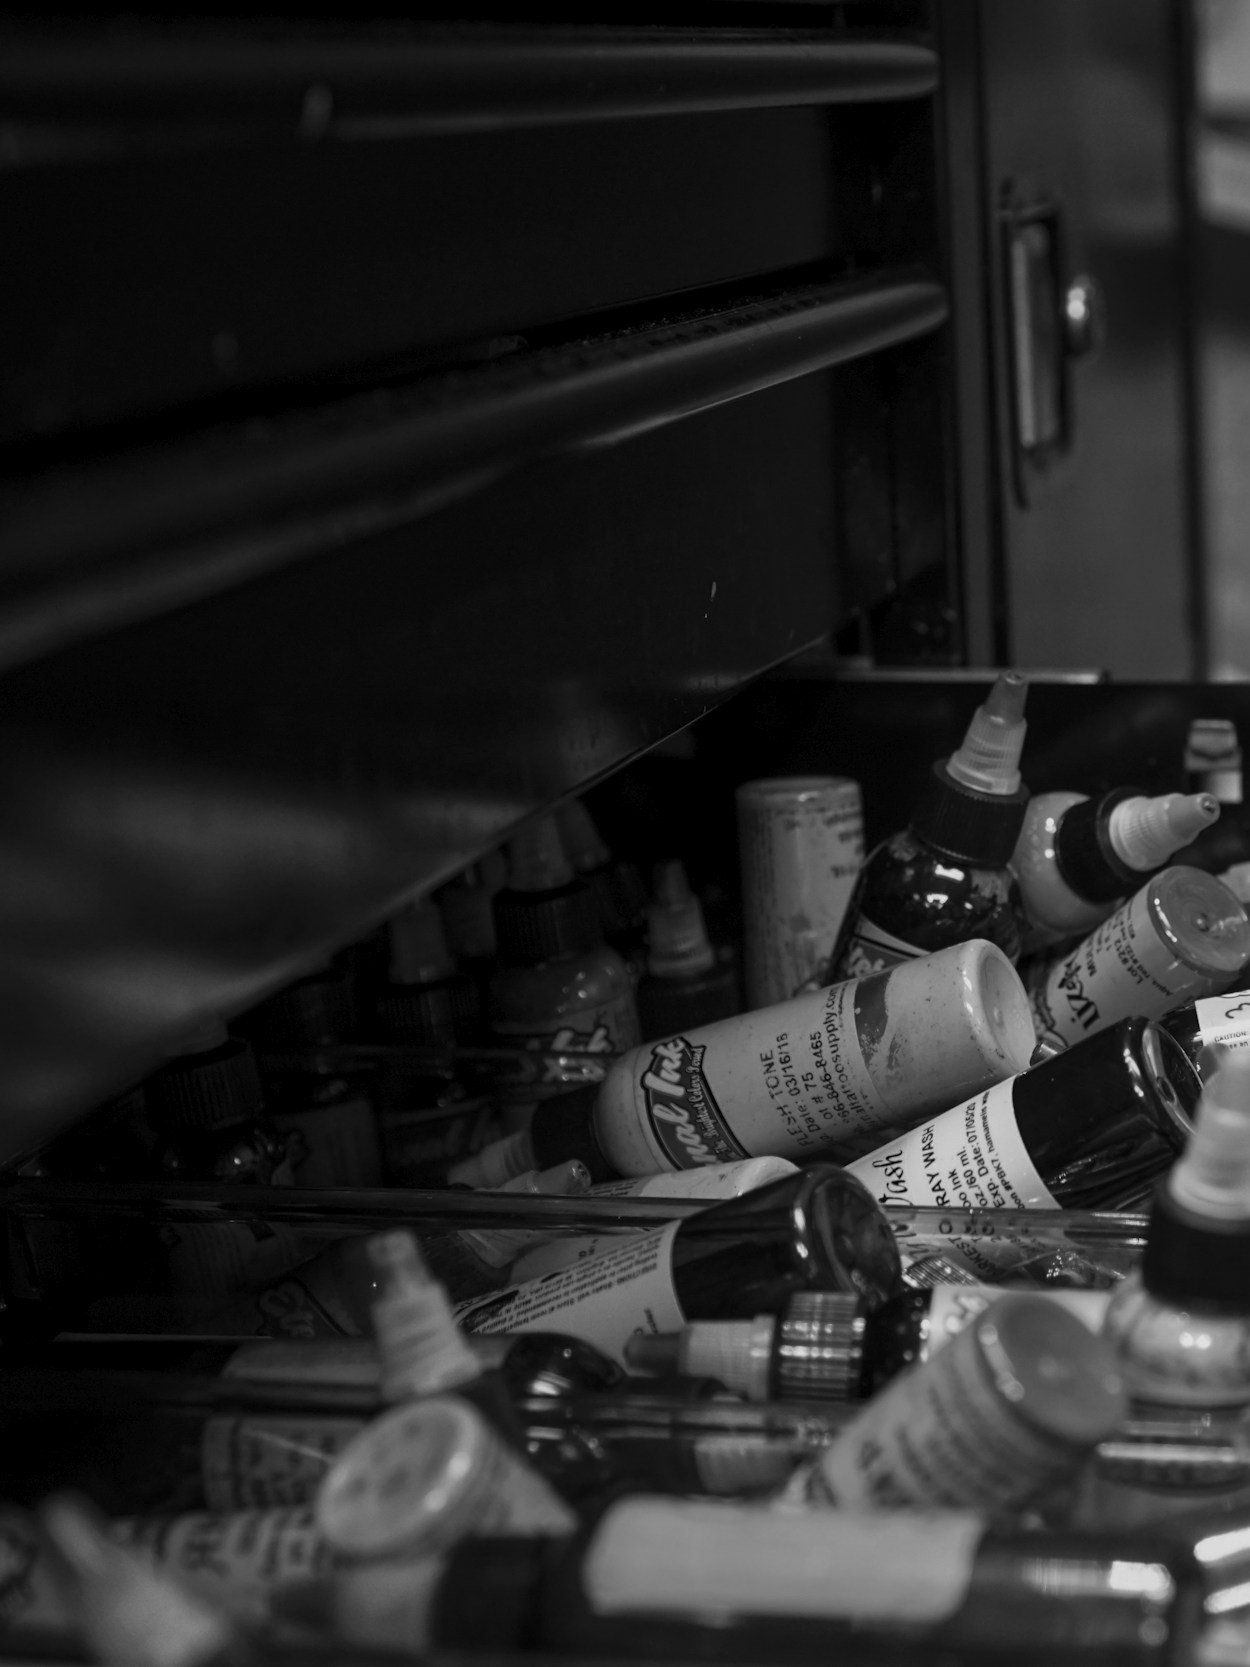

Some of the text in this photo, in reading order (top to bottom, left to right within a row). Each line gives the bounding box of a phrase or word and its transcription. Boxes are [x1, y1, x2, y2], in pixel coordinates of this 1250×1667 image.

[644, 1038, 685, 1096] Ink
[802, 1071, 817, 1091] 75
[760, 1050, 814, 1147] FLESH TONE
[921, 1124, 936, 1169] WASH
[957, 1146, 970, 1166] ml.
[972, 1141, 990, 1178] Date:
[948, 1168, 959, 1191] Ink
[986, 1177, 1006, 1209] Exp.
